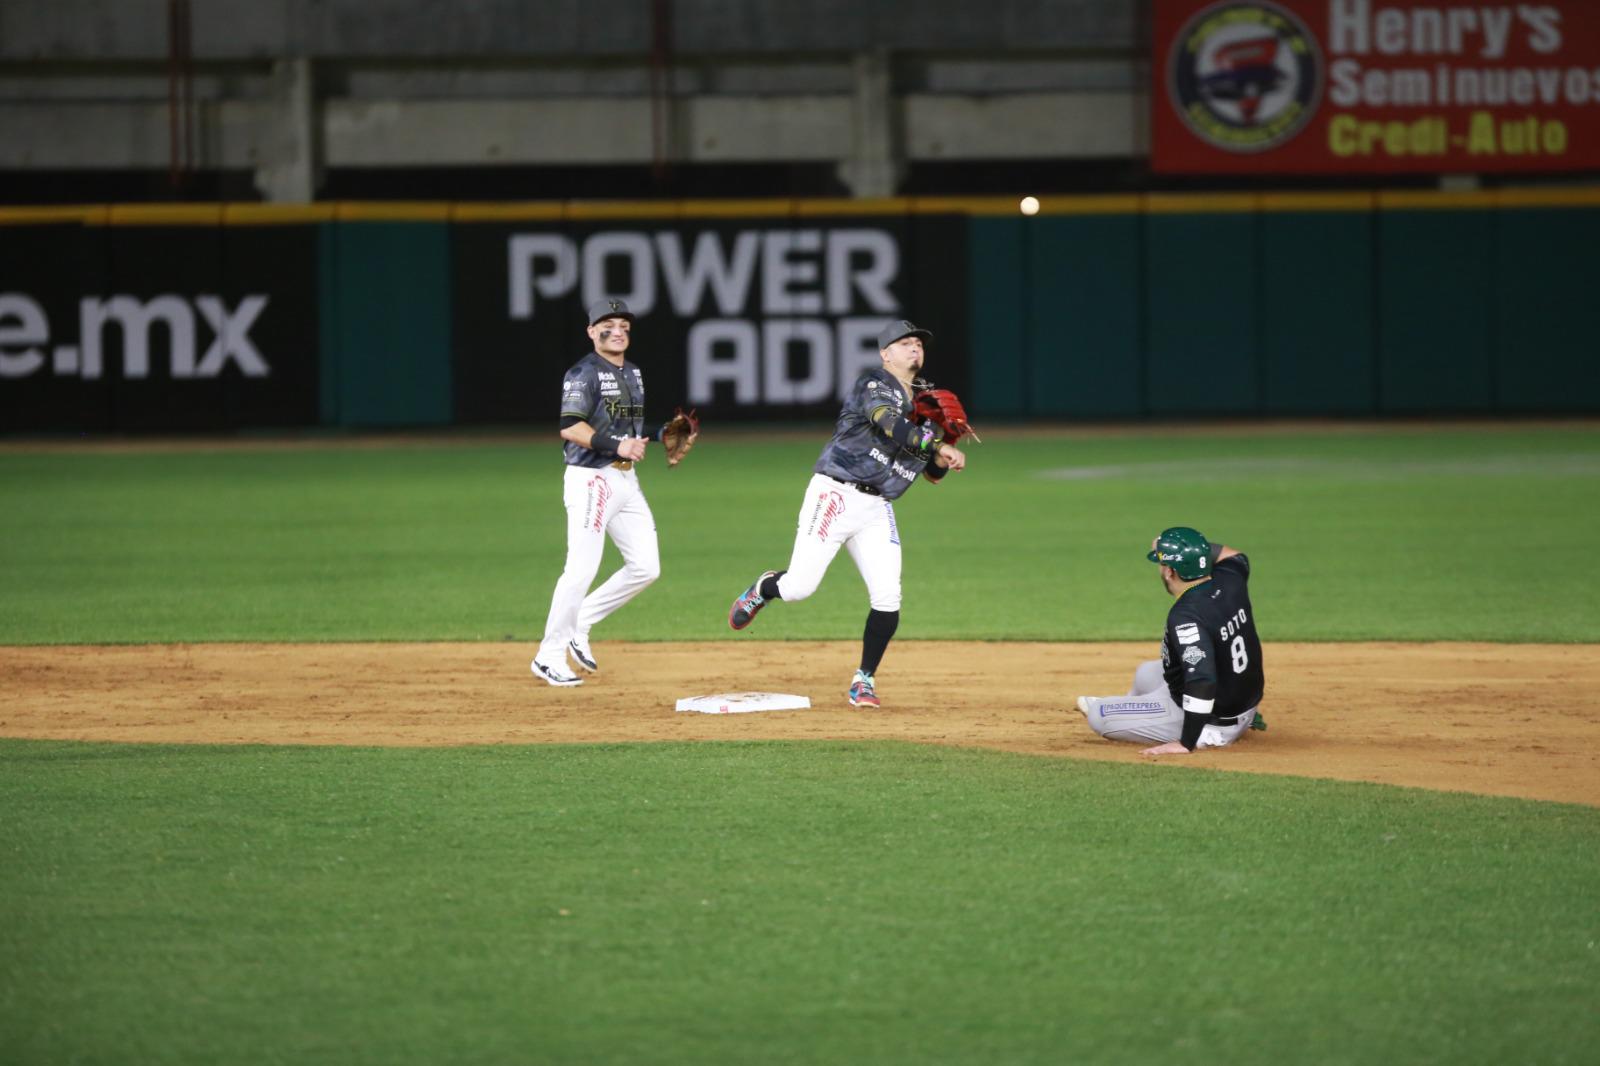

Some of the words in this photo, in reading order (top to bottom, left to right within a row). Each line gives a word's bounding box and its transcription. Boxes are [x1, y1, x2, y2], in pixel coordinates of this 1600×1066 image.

[1329, 0, 1562, 58] Henry's
[1328, 111, 1567, 156] Credi-Auto
[507, 228, 901, 319] POWER
[1199, 556, 1207, 569] 8
[1219, 608, 1248, 642] SOTO
[1230, 634, 1249, 675] 8
